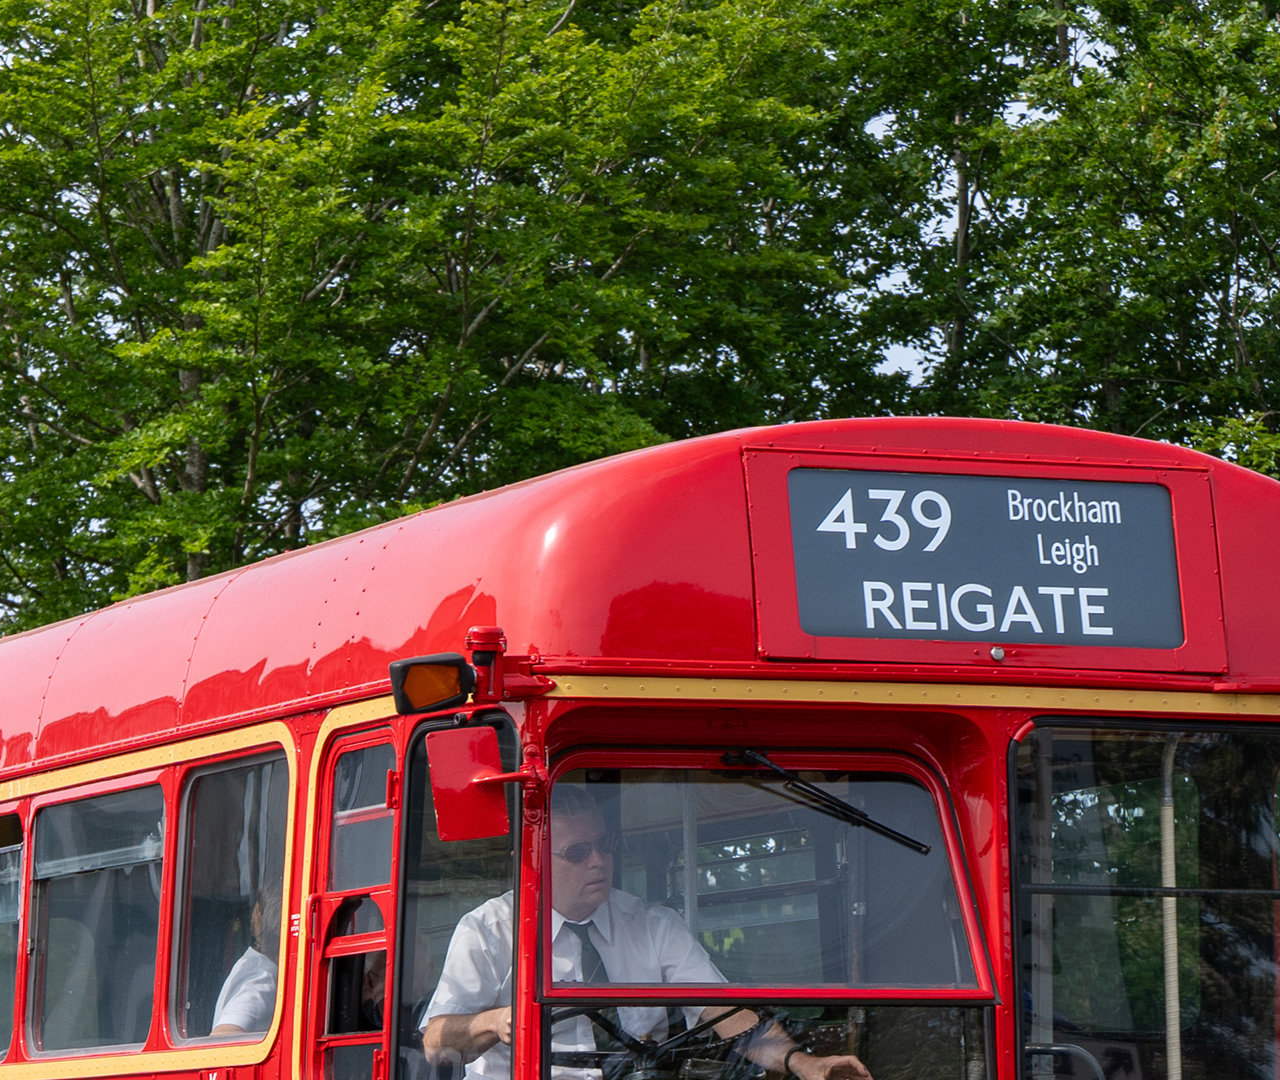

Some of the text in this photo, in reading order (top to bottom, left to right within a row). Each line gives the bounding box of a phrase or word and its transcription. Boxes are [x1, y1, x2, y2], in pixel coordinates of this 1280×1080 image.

[816, 488, 952, 552] 439
[1007, 489, 1122, 524] Brockham
[1037, 534, 1099, 574] Leigh
[863, 581, 1114, 637] REIGATE
